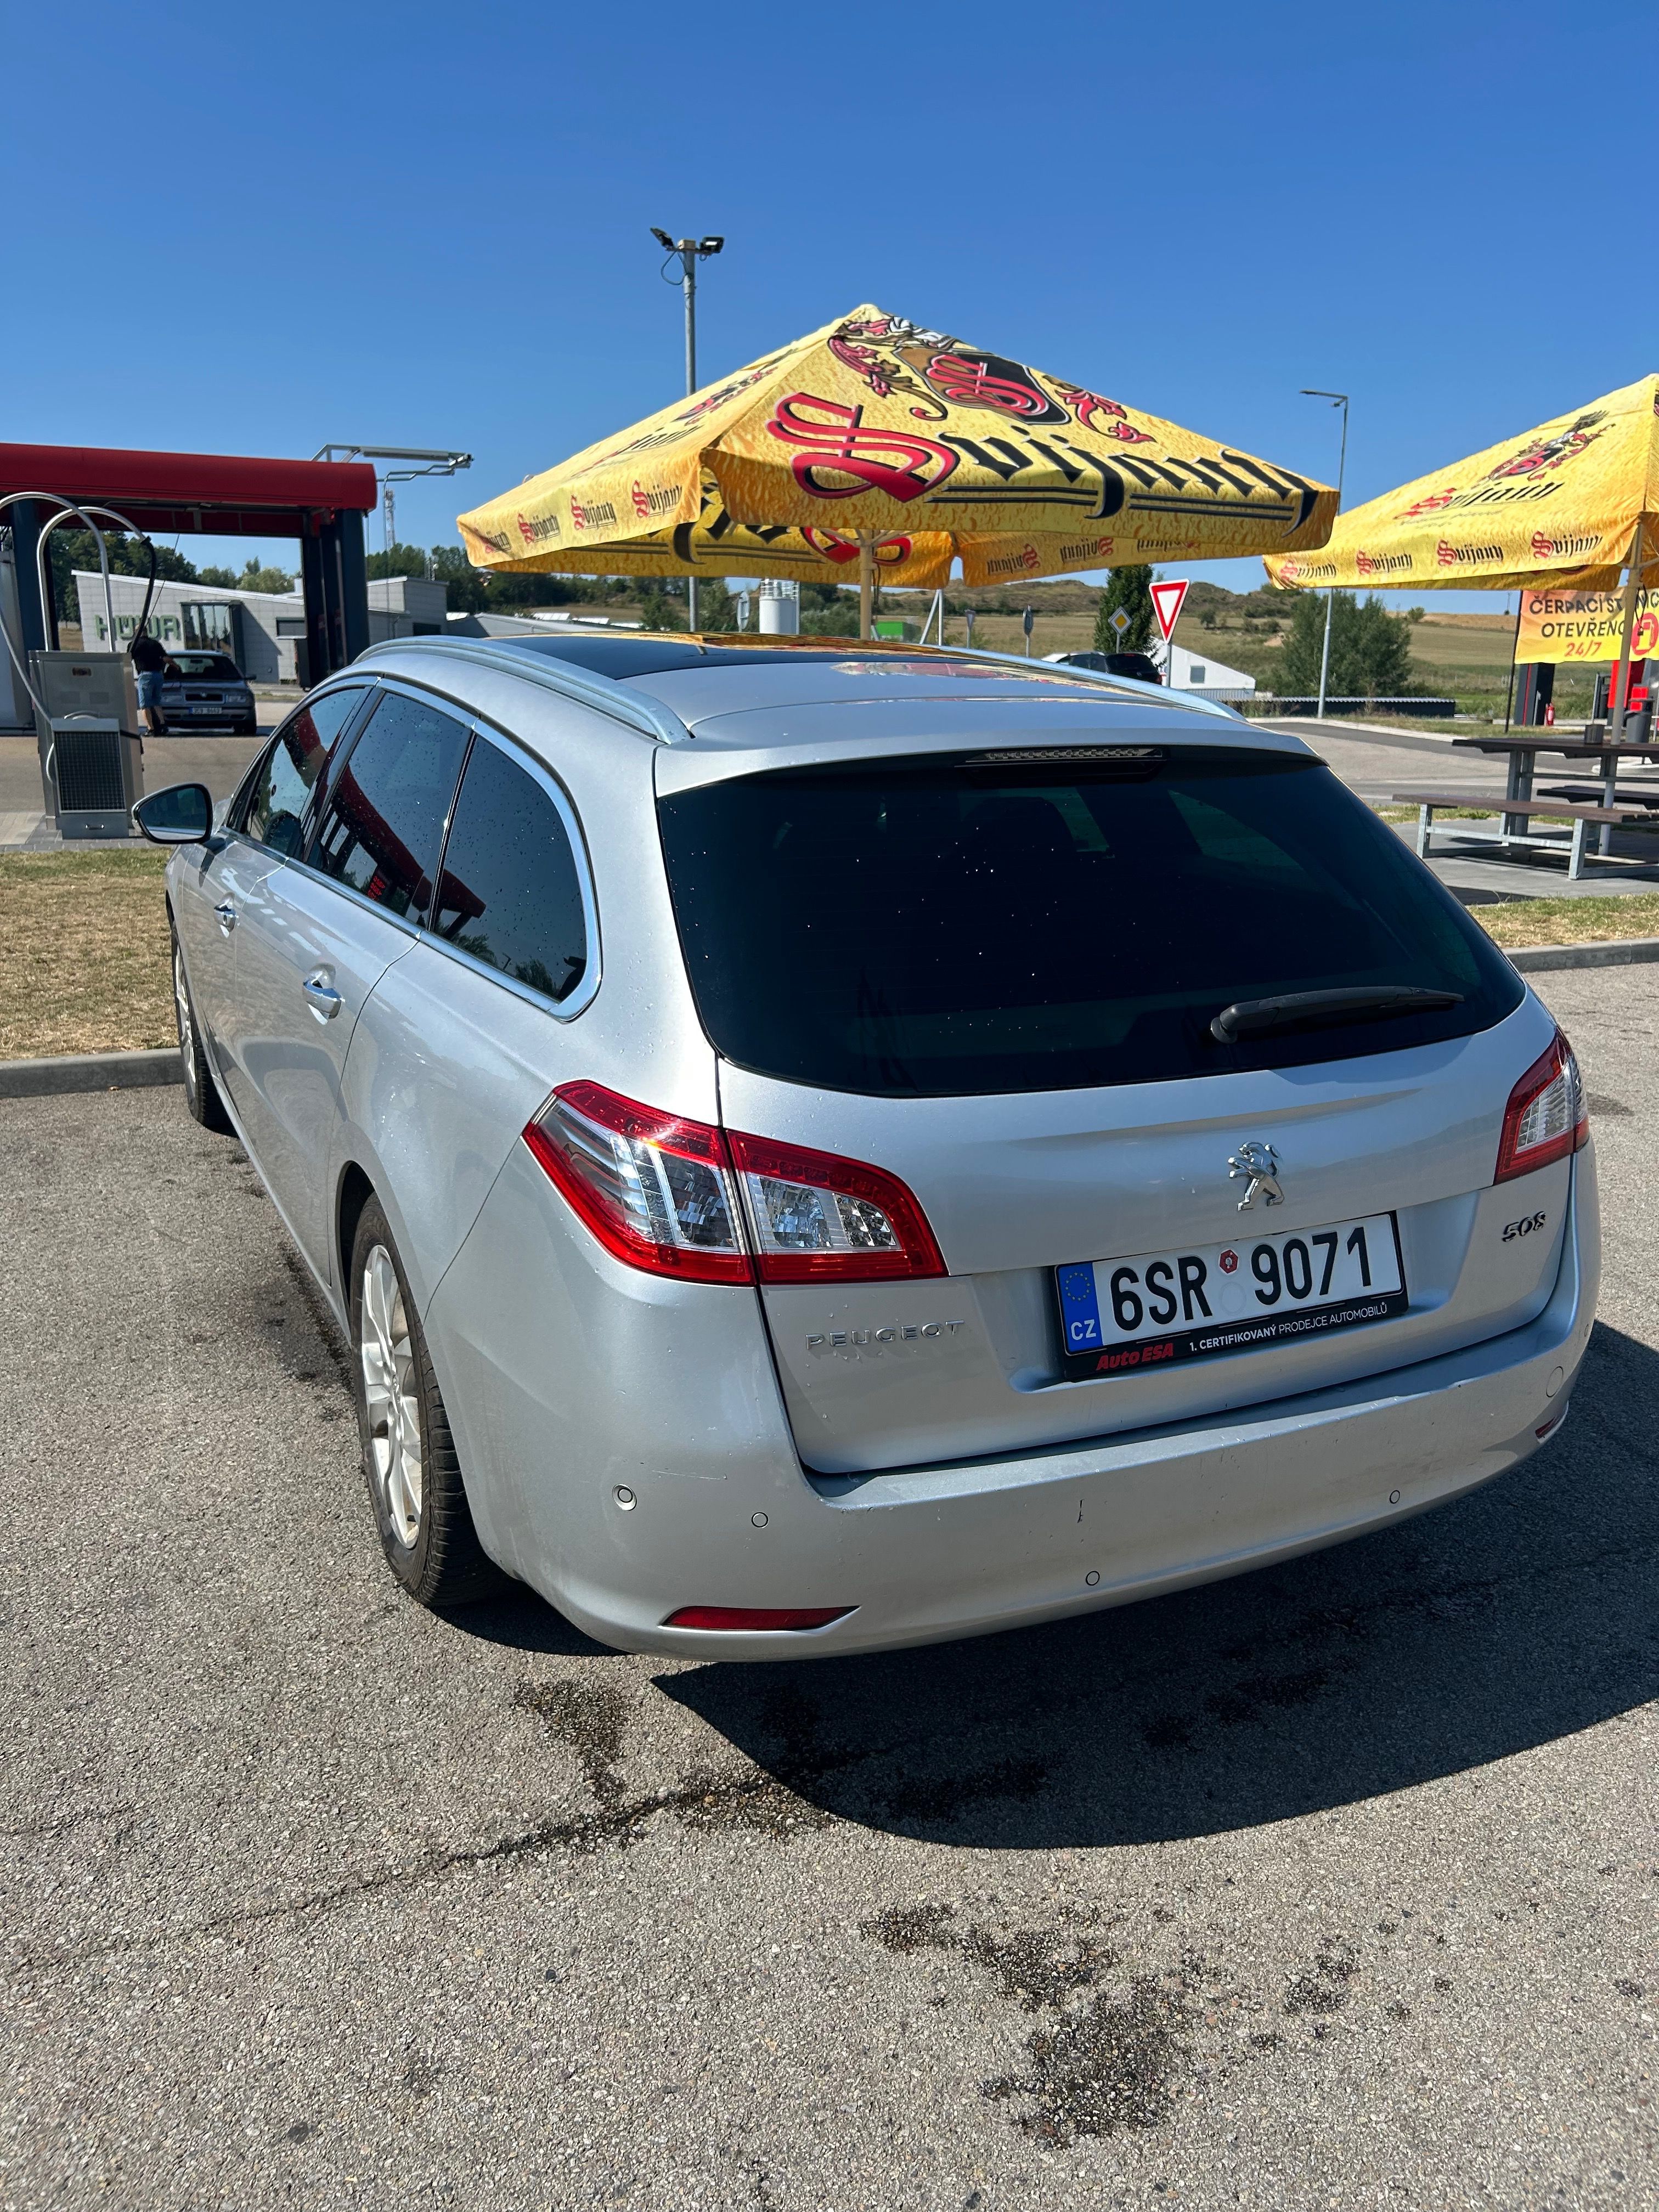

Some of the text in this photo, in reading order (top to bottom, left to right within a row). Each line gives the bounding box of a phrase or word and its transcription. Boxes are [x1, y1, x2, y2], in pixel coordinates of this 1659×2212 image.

[766, 392, 1319, 538] Svijany
[571, 494, 617, 531] Svijany
[631, 479, 682, 518] Svijany
[1437, 539, 1504, 567] Svijany
[1531, 531, 1603, 559] Svijany
[1356, 550, 1413, 575] Svijany
[1529, 594, 1603, 614] ČERPACÍ
[1565, 640, 1602, 657] 24/7
[1502, 1211, 1546, 1242] 508
[1110, 1226, 1372, 1331] 6SR 9071
[805, 1319, 965, 1350] PEUGEOT
[1070, 1319, 1097, 1341] CZ
[1189, 1301, 1387, 1352] 1. CERTIFIKOVANÝ PRODEJCE AUTOMOBILŮ
